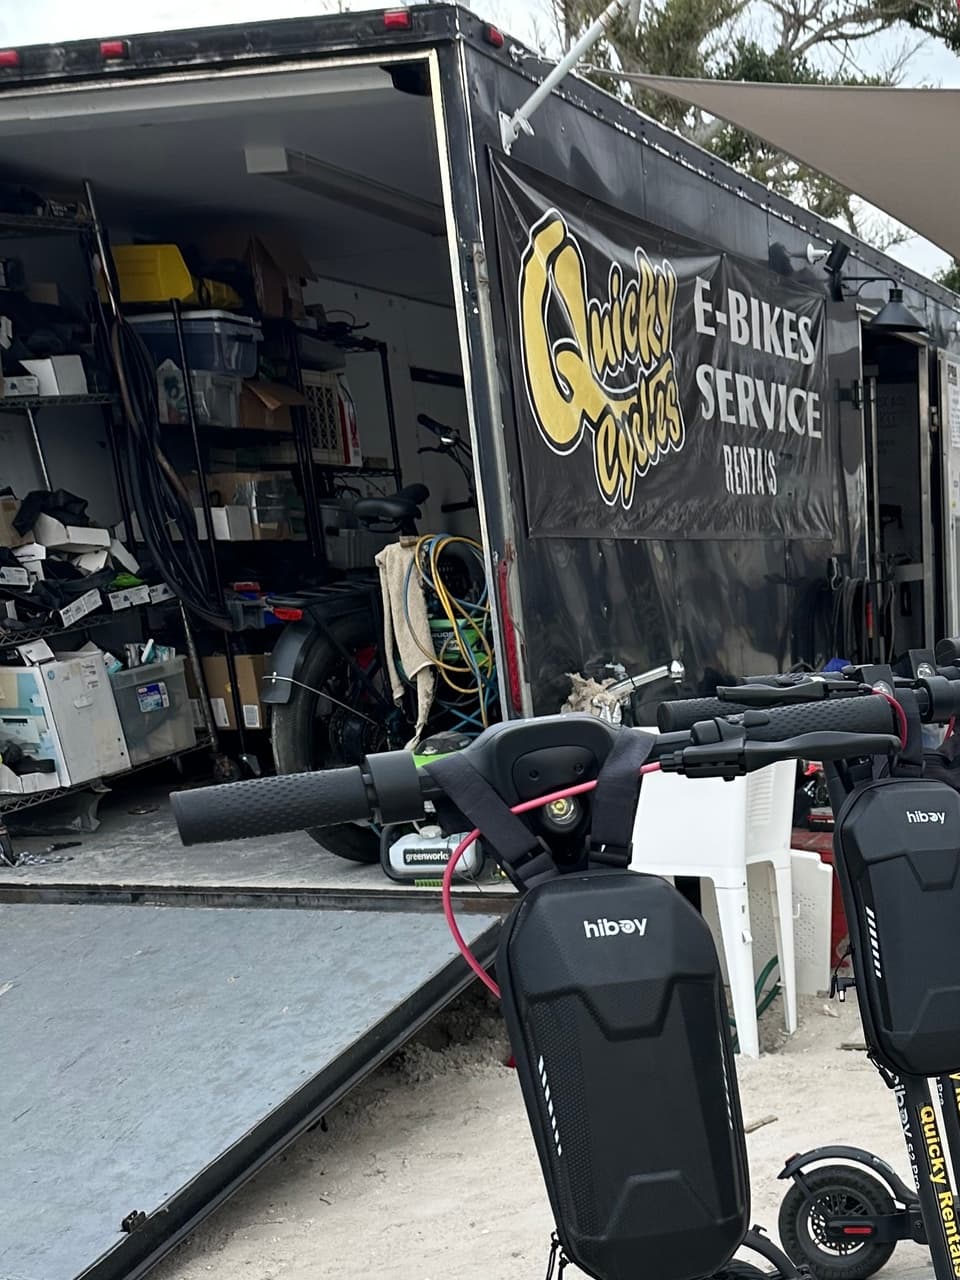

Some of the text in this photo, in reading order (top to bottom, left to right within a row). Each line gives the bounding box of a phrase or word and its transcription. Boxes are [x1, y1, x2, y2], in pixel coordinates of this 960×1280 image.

[519, 208, 678, 455] Quicky
[694, 276, 816, 366] E-BIKES
[696, 364, 823, 439] SERVICE
[906, 811, 946, 825] hiboy
[405, 851, 450, 862] greenworks
[584, 918, 648, 938] hiboy
[920, 1105, 947, 1185] Quicky
